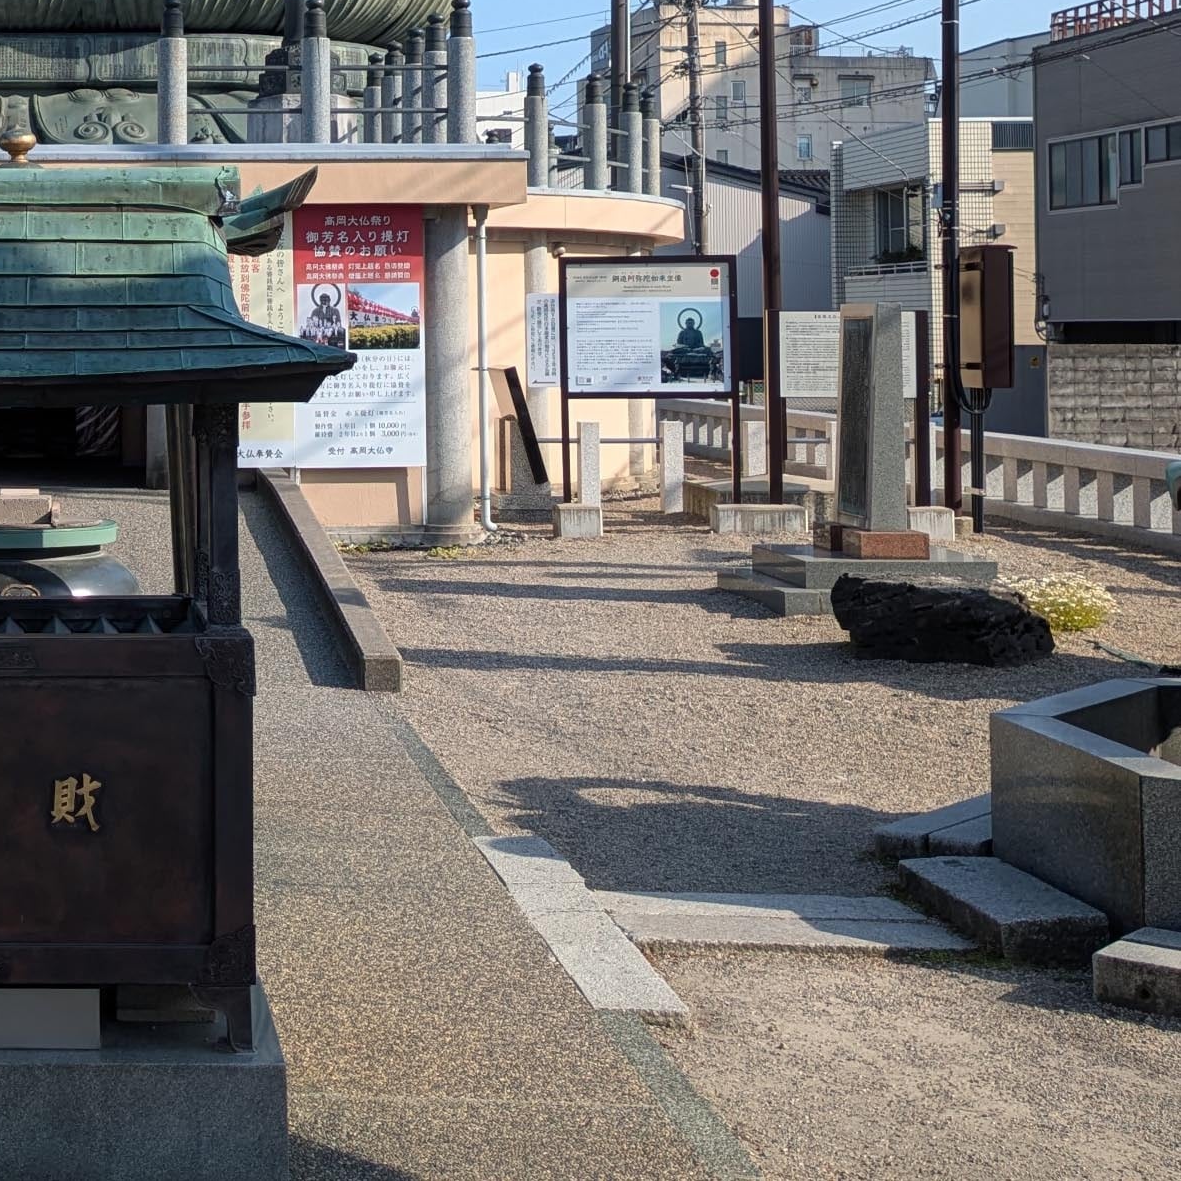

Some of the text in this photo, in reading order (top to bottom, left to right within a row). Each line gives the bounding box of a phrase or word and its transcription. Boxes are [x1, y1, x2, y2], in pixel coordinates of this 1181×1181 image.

[324, 215, 391, 227] 高岡大仏祭り
[306, 230, 410, 244] 御芳名入り提灯
[313, 244, 402, 258] 協賛のお願い
[327, 446, 394, 455] 受付 高岡大仏寺
[51, 773, 102, 832] 財
